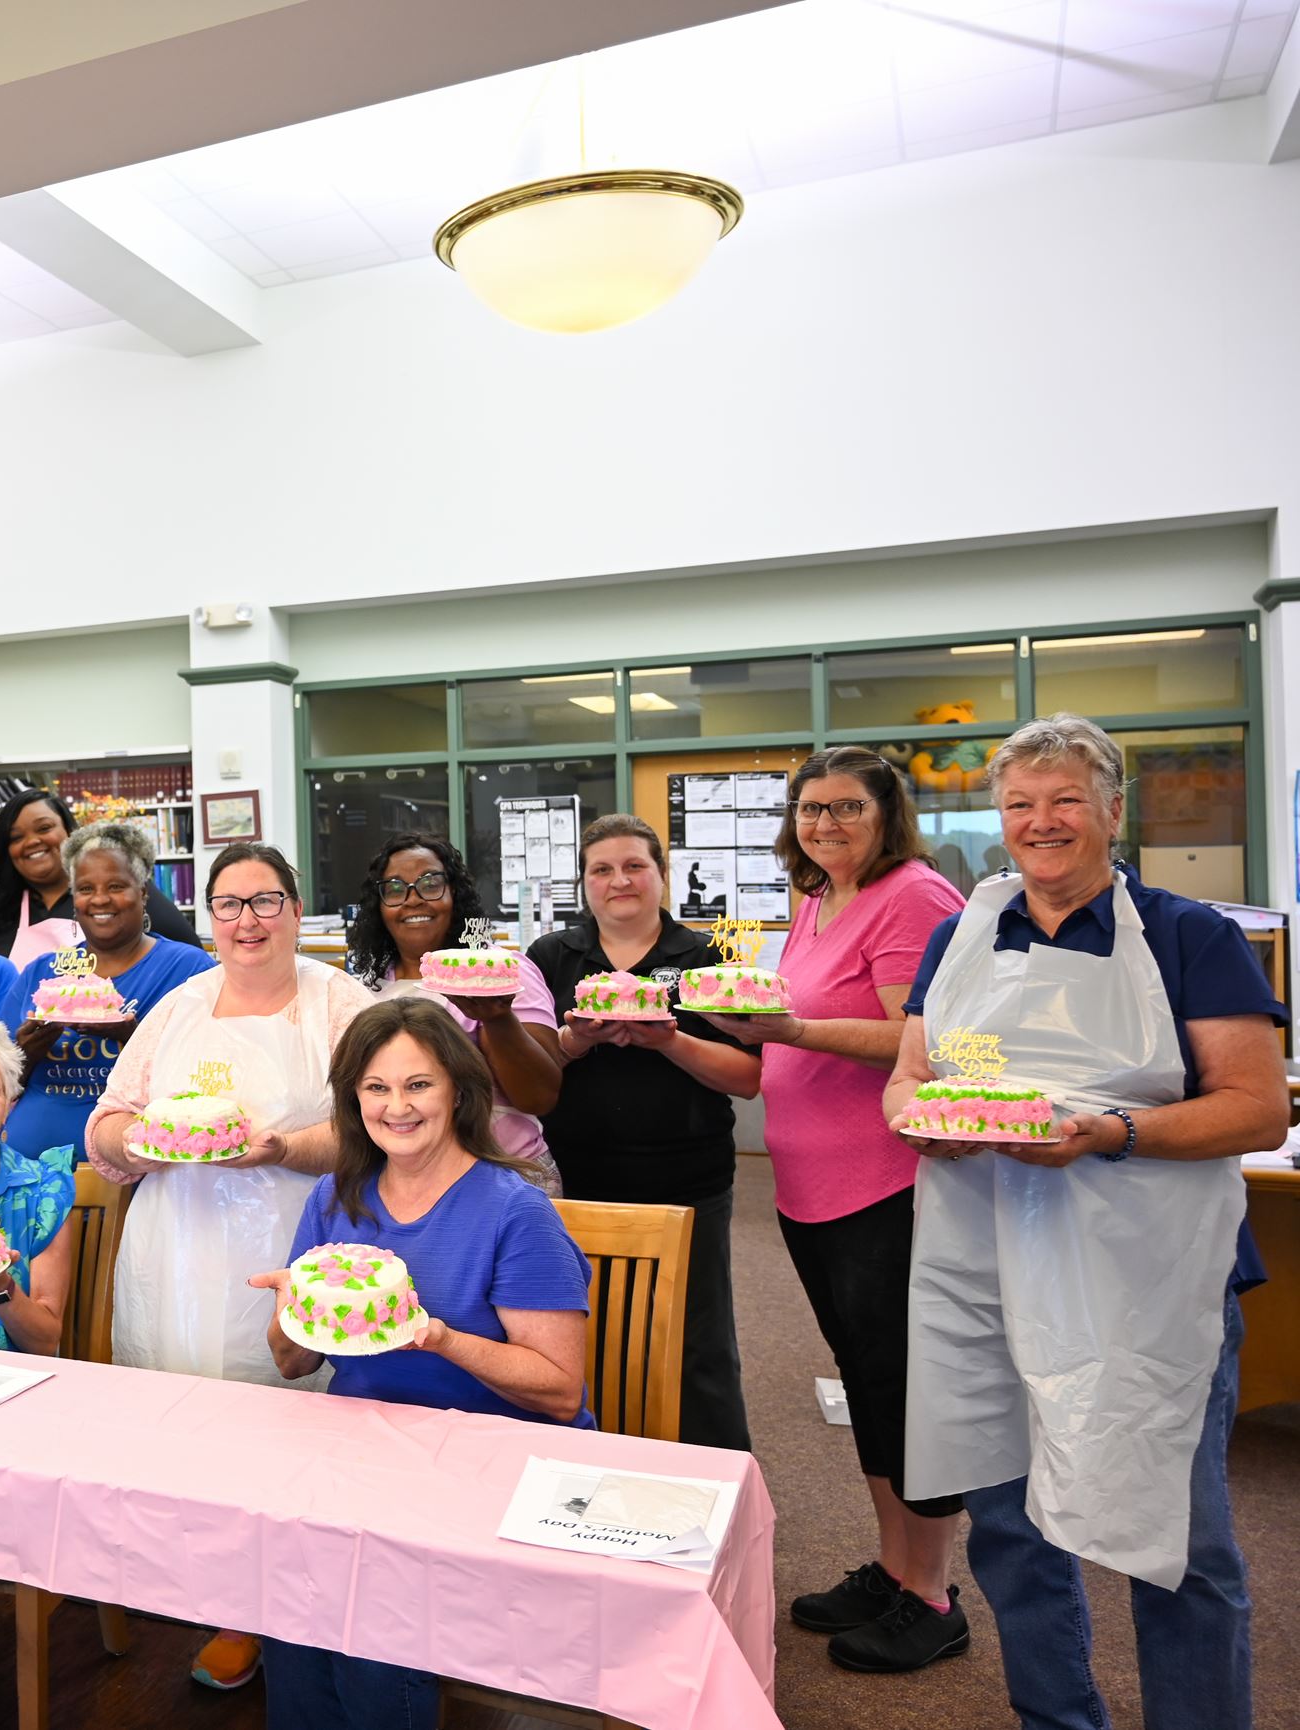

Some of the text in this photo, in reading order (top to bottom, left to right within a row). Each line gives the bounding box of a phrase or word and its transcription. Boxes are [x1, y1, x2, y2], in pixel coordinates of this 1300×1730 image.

[500, 800, 547, 810] CPR TECHNIQUES
[711, 914, 763, 932] Happy
[657, 974, 676, 983] TBA
[939, 1026, 1002, 1047] Happy
[46, 1064, 114, 1081] change
[197, 1060, 232, 1078] HAPPY
[957, 1058, 1005, 1077] Day
[538, 1518, 677, 1541] Mother's Day
[571, 1532, 638, 1547] Happy
